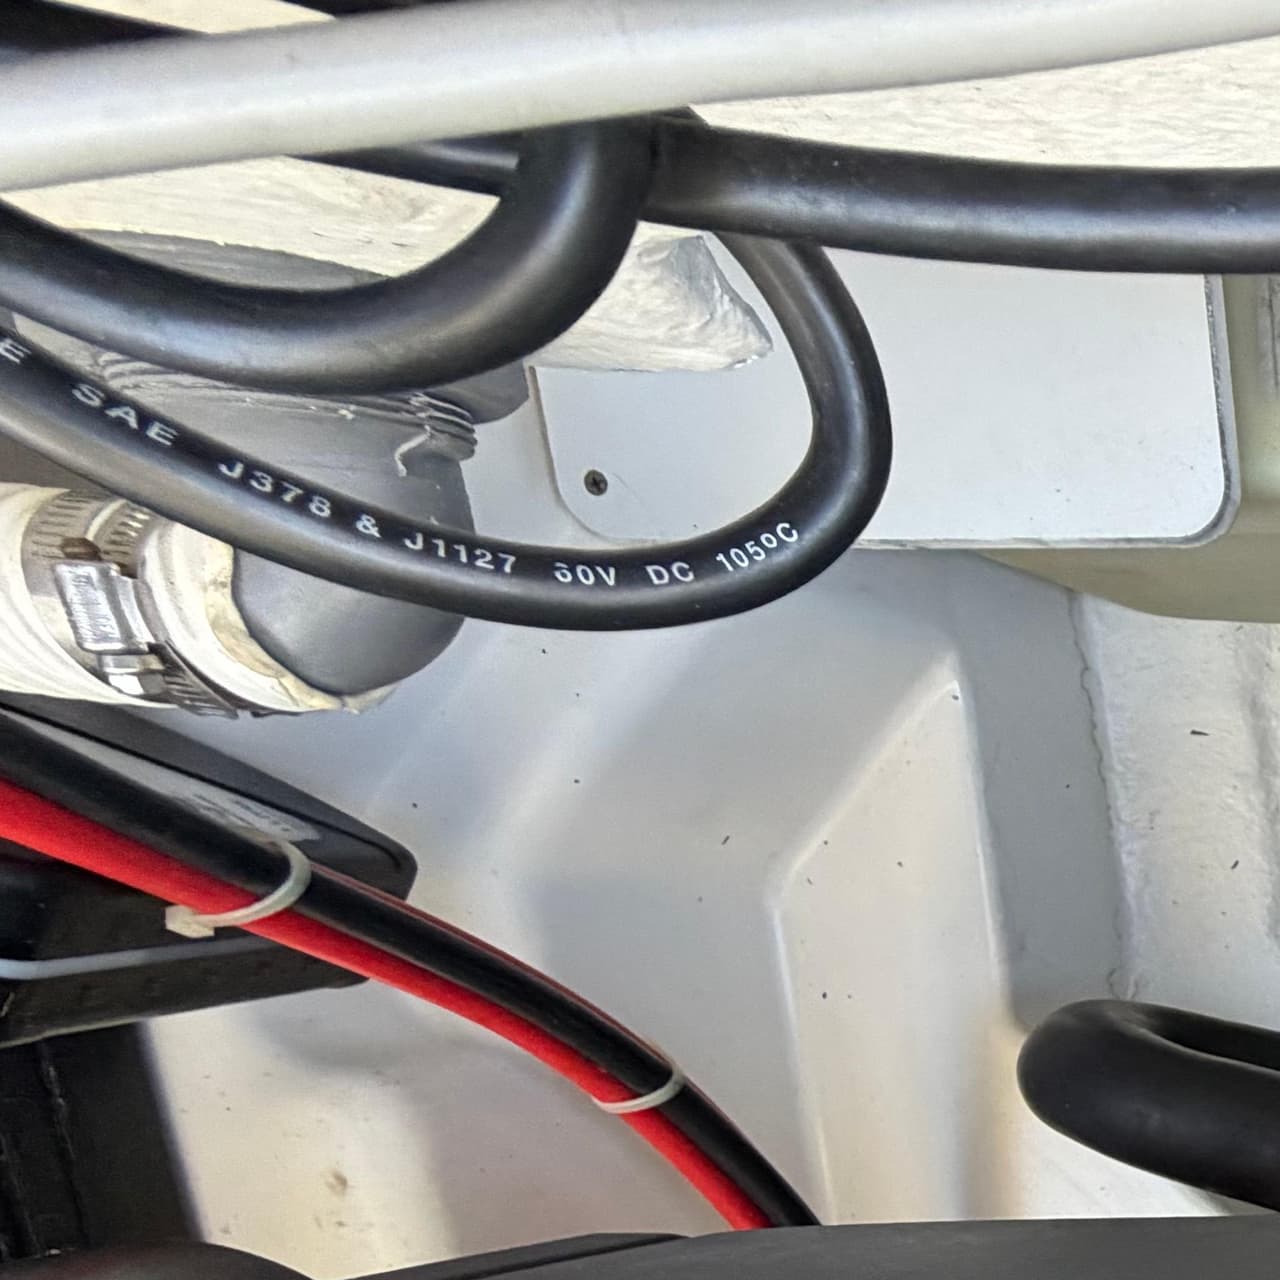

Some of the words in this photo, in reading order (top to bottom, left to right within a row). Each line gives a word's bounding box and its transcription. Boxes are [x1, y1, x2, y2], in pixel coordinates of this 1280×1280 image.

[71, 383, 180, 447] SAE
[218, 461, 332, 520] J378
[356, 515, 383, 539] &
[403, 536, 517, 574] J1127
[647, 563, 695, 586] DC
